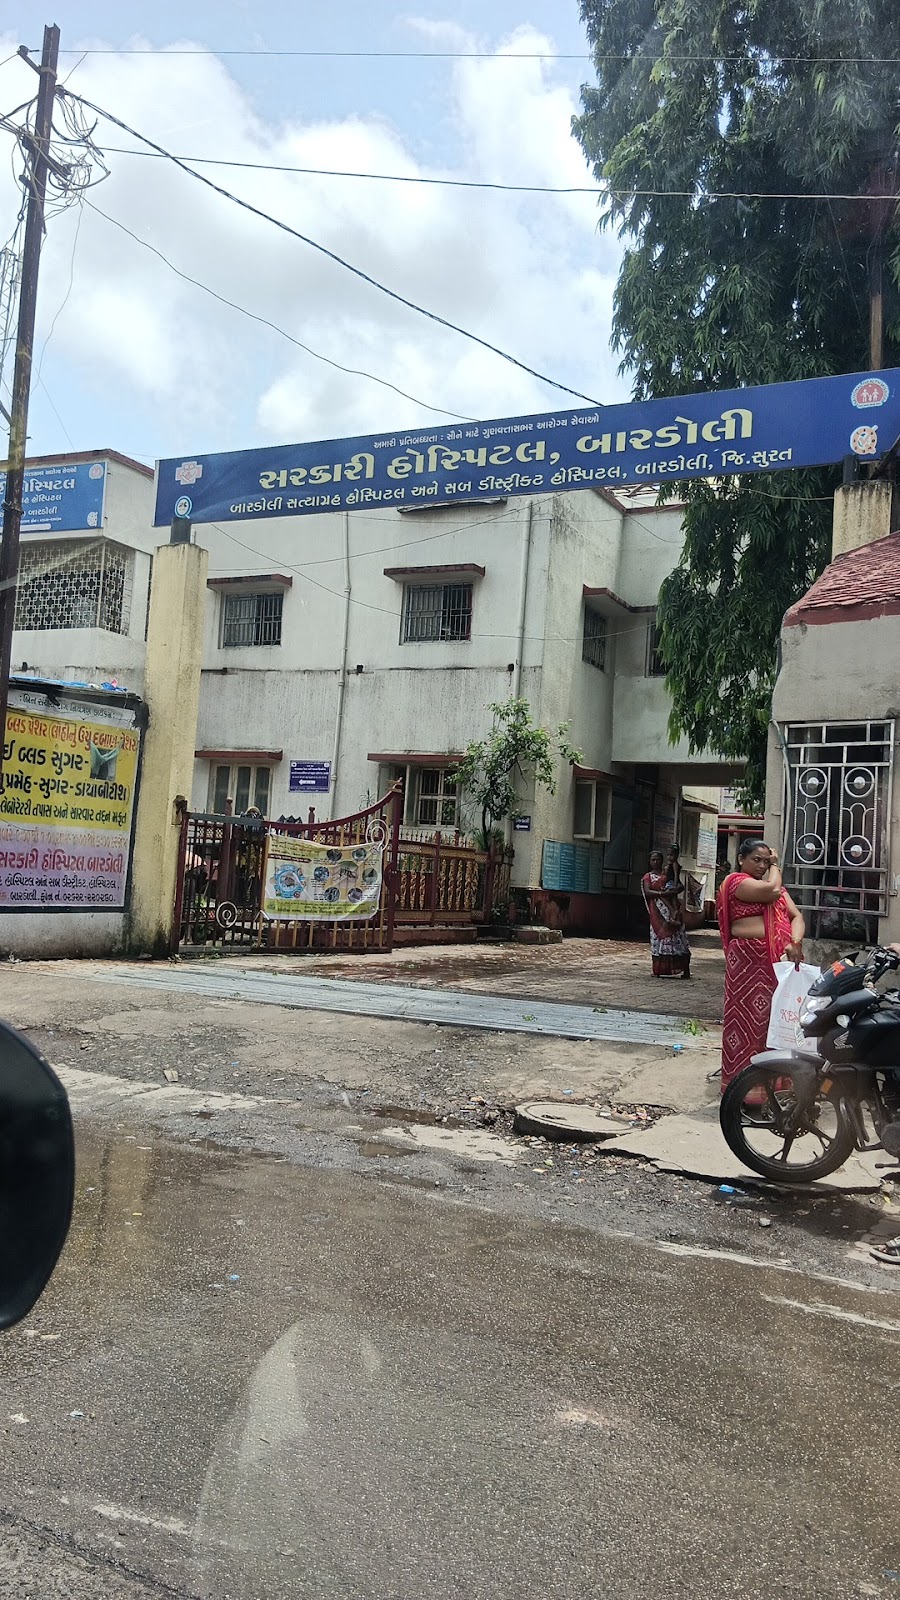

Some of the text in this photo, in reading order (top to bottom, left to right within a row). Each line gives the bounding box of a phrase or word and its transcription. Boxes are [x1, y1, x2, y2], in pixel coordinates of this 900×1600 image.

[373, 437, 396, 450] અમારી
[446, 430, 463, 442] સૌને
[465, 427, 480, 438] માટે
[482, 423, 533, 439] ગુણવત્તાસભર
[536, 417, 568, 430] આરોગ્ય
[570, 412, 600, 426] સેવાઓ
[259, 408, 753, 490] સરકારી હોસ્પિટલ, બારડોલી
[230, 497, 282, 514] બારડોલી
[286, 492, 341, 509] સત્યાગ્રહ
[345, 487, 405, 505] હોસ્પિટલ
[411, 481, 438, 497] અને
[444, 481, 471, 494] સબ
[550, 465, 628, 485] હોસ્પિટલ,
[635, 455, 714, 475] બારડોલી,
[31, 494, 62, 504] હોસ્પિટલ
[28, 506, 58, 516] બારડોલી
[7, 716, 26, 734] બ્લડ
[18, 746, 46, 765] બ્લડ
[0, 796, 32, 816] લેબોરેટરી
[32, 803, 52, 818] તપાસ
[54, 802, 69, 819] અને
[70, 807, 94, 821] સારવાર
[112, 811, 127, 827] મફત
[0, 848, 39, 869] સરકારી
[5, 873, 34, 888] હોસ્પિટલ
[35, 874, 48, 887] અને
[48, 877, 61, 888] સબ
[780, 1008, 800, 1022] KES
